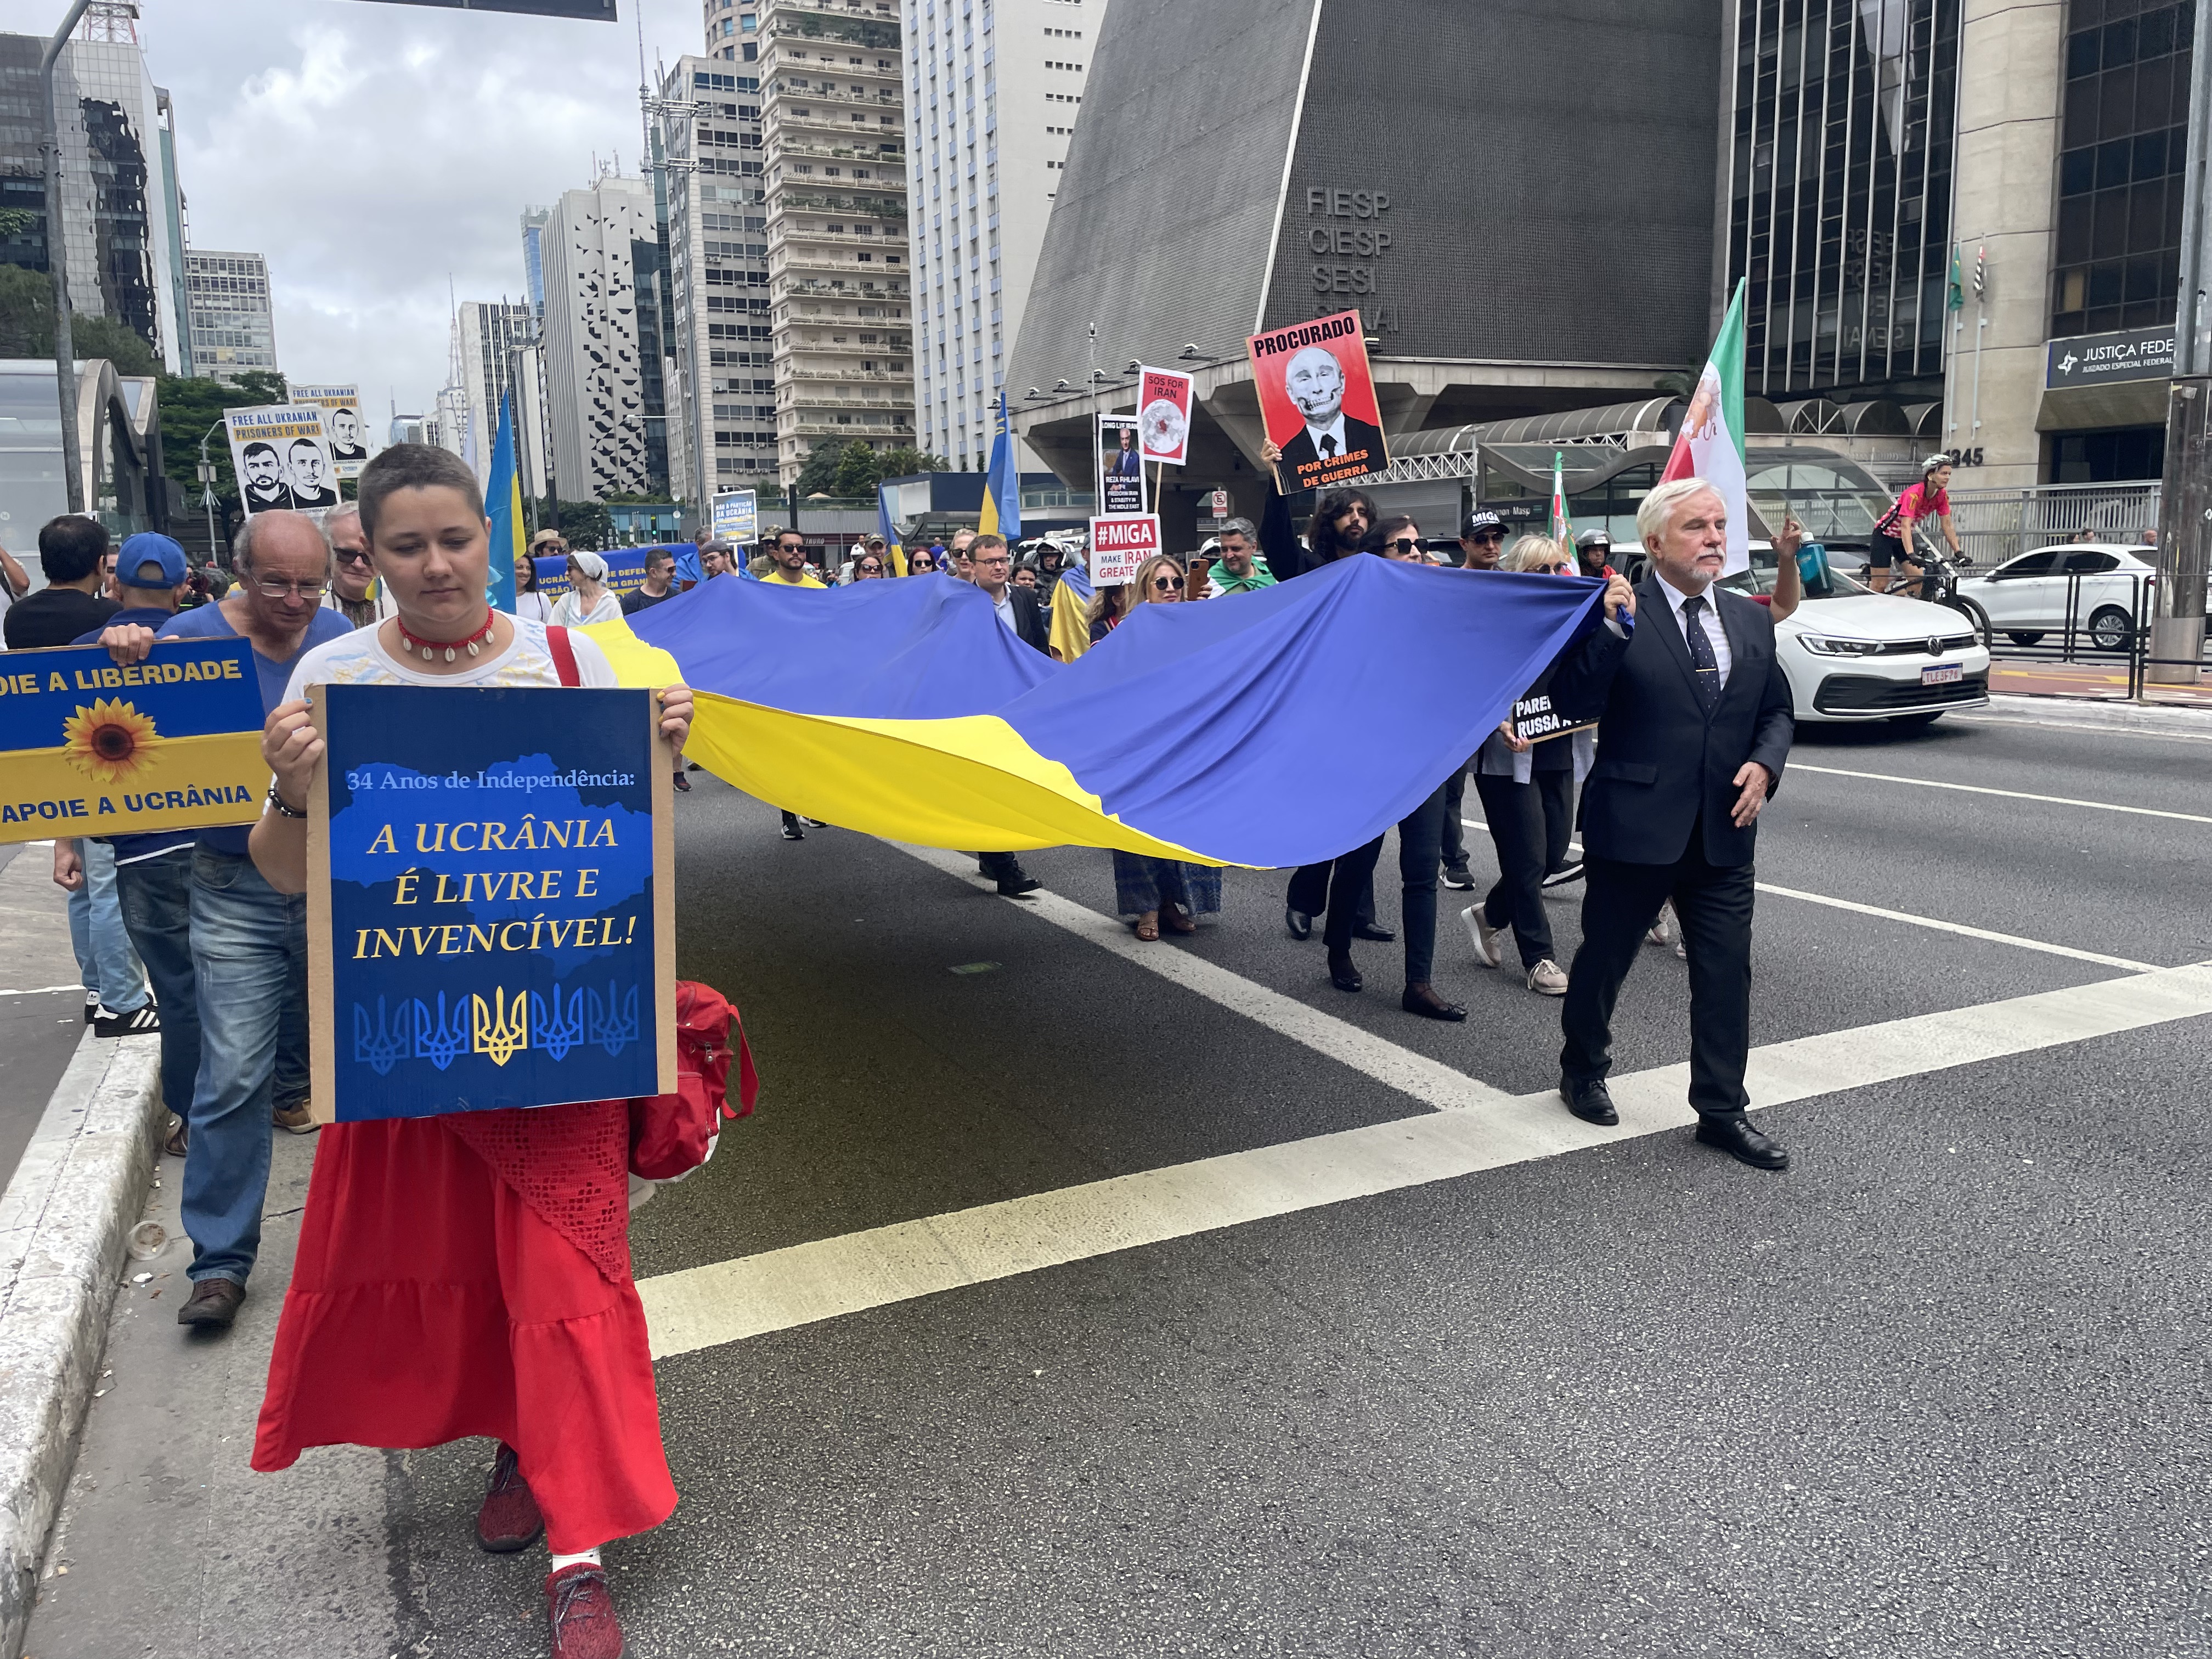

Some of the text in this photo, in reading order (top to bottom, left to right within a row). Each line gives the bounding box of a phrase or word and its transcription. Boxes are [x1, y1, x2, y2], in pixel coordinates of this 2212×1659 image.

[1308, 188, 1390, 218] FIESP
[1309, 228, 1392, 256] CIESP
[1313, 264, 1375, 294] SESI
[1254, 317, 1355, 358] PROCURADO
[2083, 343, 2136, 361] JUSTIÇA
[2143, 357, 2174, 366] FEDERAL
[293, 390, 309, 398] FREE
[324, 388, 355, 397] UKRANIAN
[1148, 376, 1183, 389] SOS FOR
[1154, 387, 1177, 398] IRAN
[232, 411, 317, 426] FREE ALL UKRANIAN
[235, 425, 320, 439] PRISONERS OF WAR!
[1296, 449, 1369, 475] POR CRIMES
[1302, 464, 1369, 488] DE GUERRA
[726, 507, 752, 516] UCRÂNIA
[1472, 511, 1500, 523] MIGA
[1097, 523, 1153, 546] #MIGA
[1101, 550, 1151, 565] MAKE IRAN
[1099, 566, 1134, 578] GREATE
[49, 672, 68, 692] A
[75, 659, 242, 690] LIBERDADE
[1517, 713, 1560, 738] RUSSA
[347, 769, 635, 794] 34 Anos de Independência:
[2, 784, 252, 823] APOIE A UCRÂNIA
[366, 814, 619, 855] A UCRÂNIA
[392, 867, 599, 905] É LIVRE E
[352, 913, 637, 959] INVENCÍVEL!
